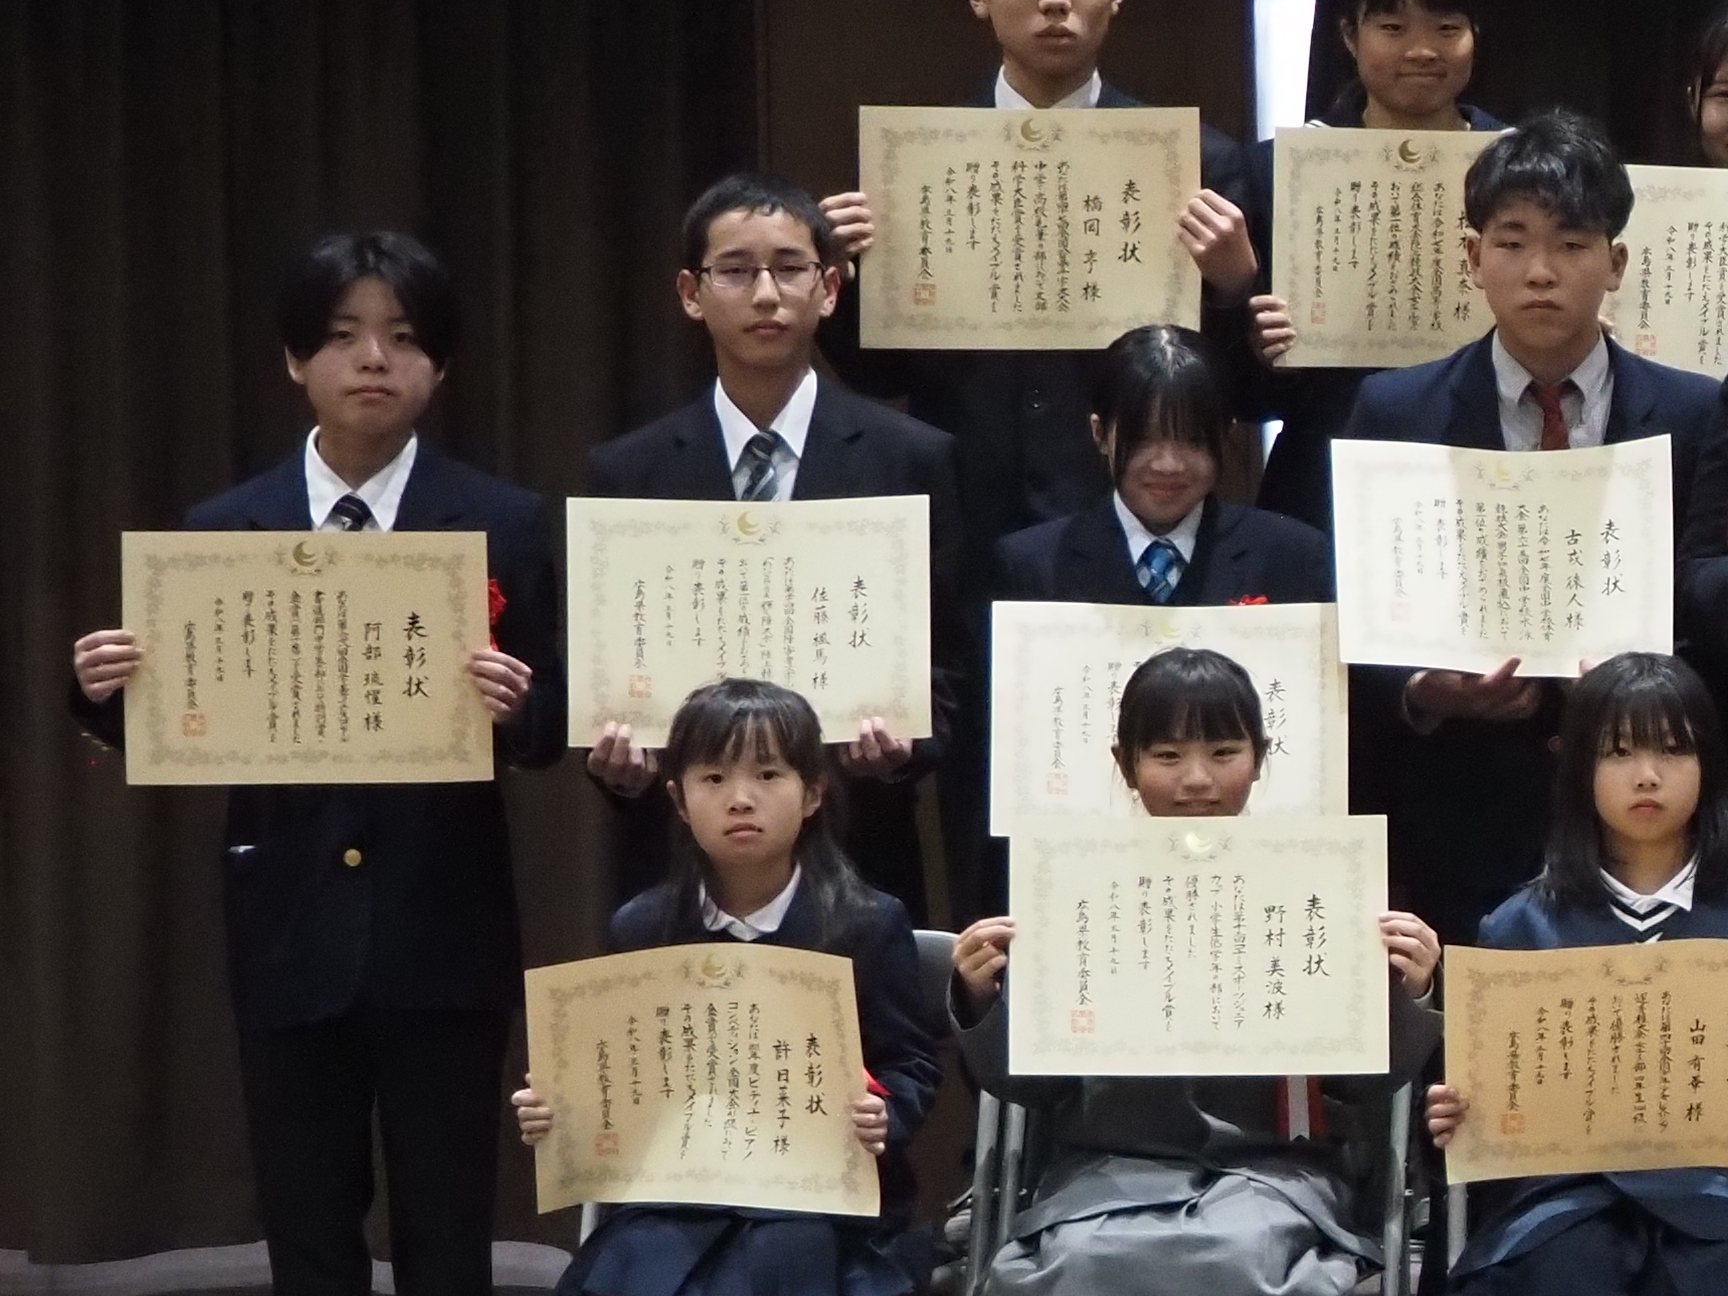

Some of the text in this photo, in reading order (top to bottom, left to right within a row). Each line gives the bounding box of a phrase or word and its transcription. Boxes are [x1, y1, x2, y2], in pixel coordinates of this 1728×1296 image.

[1118, 179, 1142, 264] 表彰状
[1600, 519, 1624, 595] 表彰状
[848, 576, 870, 648] 表彰状
[402, 611, 430, 698] 表彰状
[1077, 900, 1091, 1005] 広島県教育委員会
[1263, 905, 1286, 1020] 野村美波様
[1303, 894, 1329, 976] 表彰状
[804, 1033, 828, 1116] 表彰状
